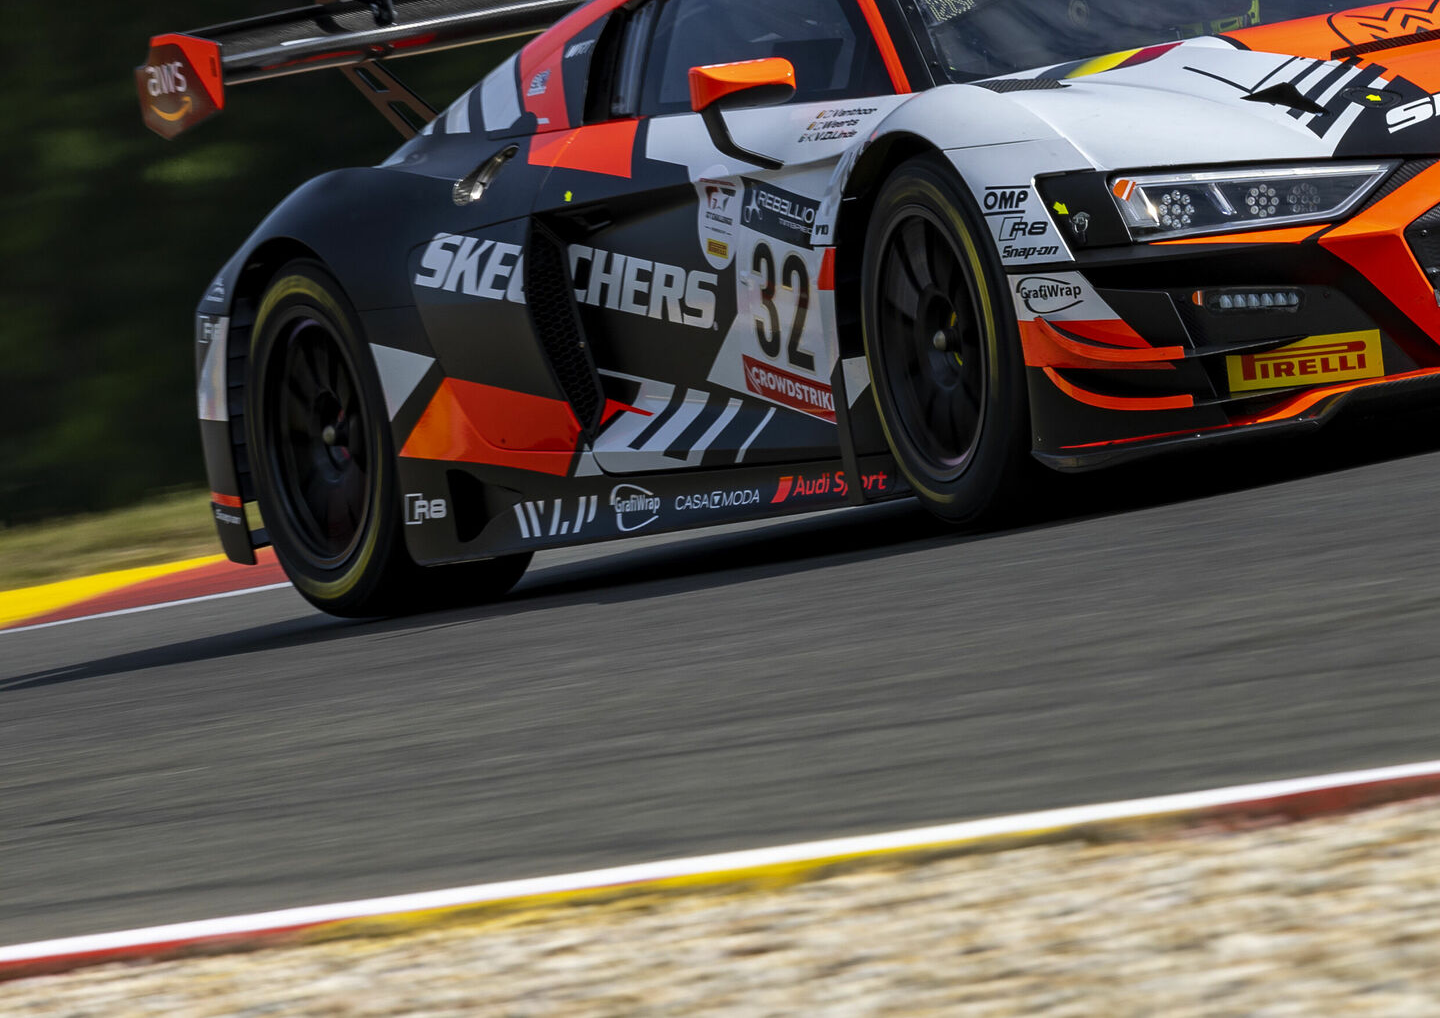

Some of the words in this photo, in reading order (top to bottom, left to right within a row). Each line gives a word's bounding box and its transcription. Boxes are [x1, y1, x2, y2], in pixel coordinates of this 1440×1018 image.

[145, 61, 188, 97] aws
[758, 190, 815, 224] REBELLIO
[983, 189, 1029, 211] OMP
[1006, 219, 1049, 239] R8
[1002, 245, 1060, 260] Snap-on
[1020, 284, 1082, 300] GrafiWrap
[752, 239, 816, 376] 32
[1241, 340, 1367, 381] PIRELLI
[793, 472, 831, 496] Audi
[412, 497, 447, 520] R8
[613, 494, 661, 514] GrafiWrap
